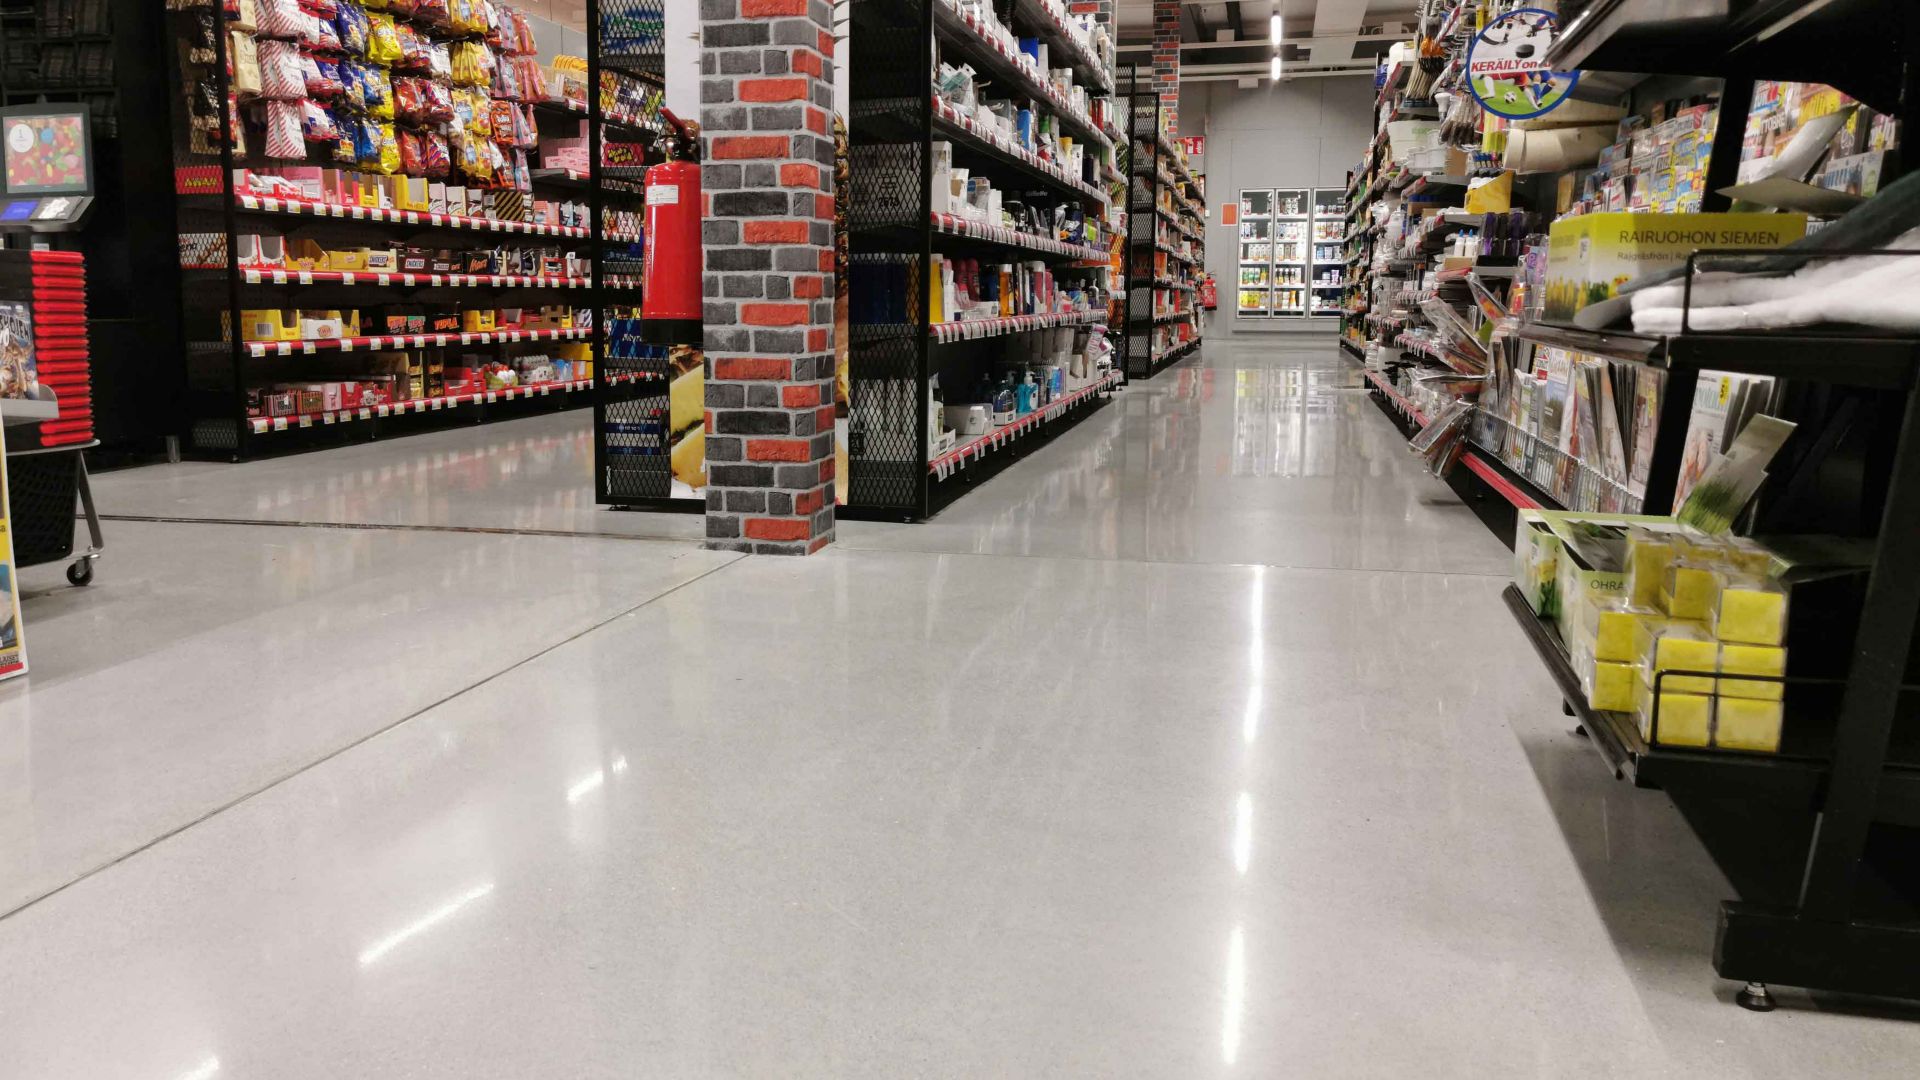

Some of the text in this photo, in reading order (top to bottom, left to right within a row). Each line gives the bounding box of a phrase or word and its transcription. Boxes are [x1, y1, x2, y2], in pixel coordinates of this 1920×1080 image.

[1471, 58, 1521, 72] KERÄILY
[1619, 230, 1779, 245] RAIRUOHON SIEMEN
